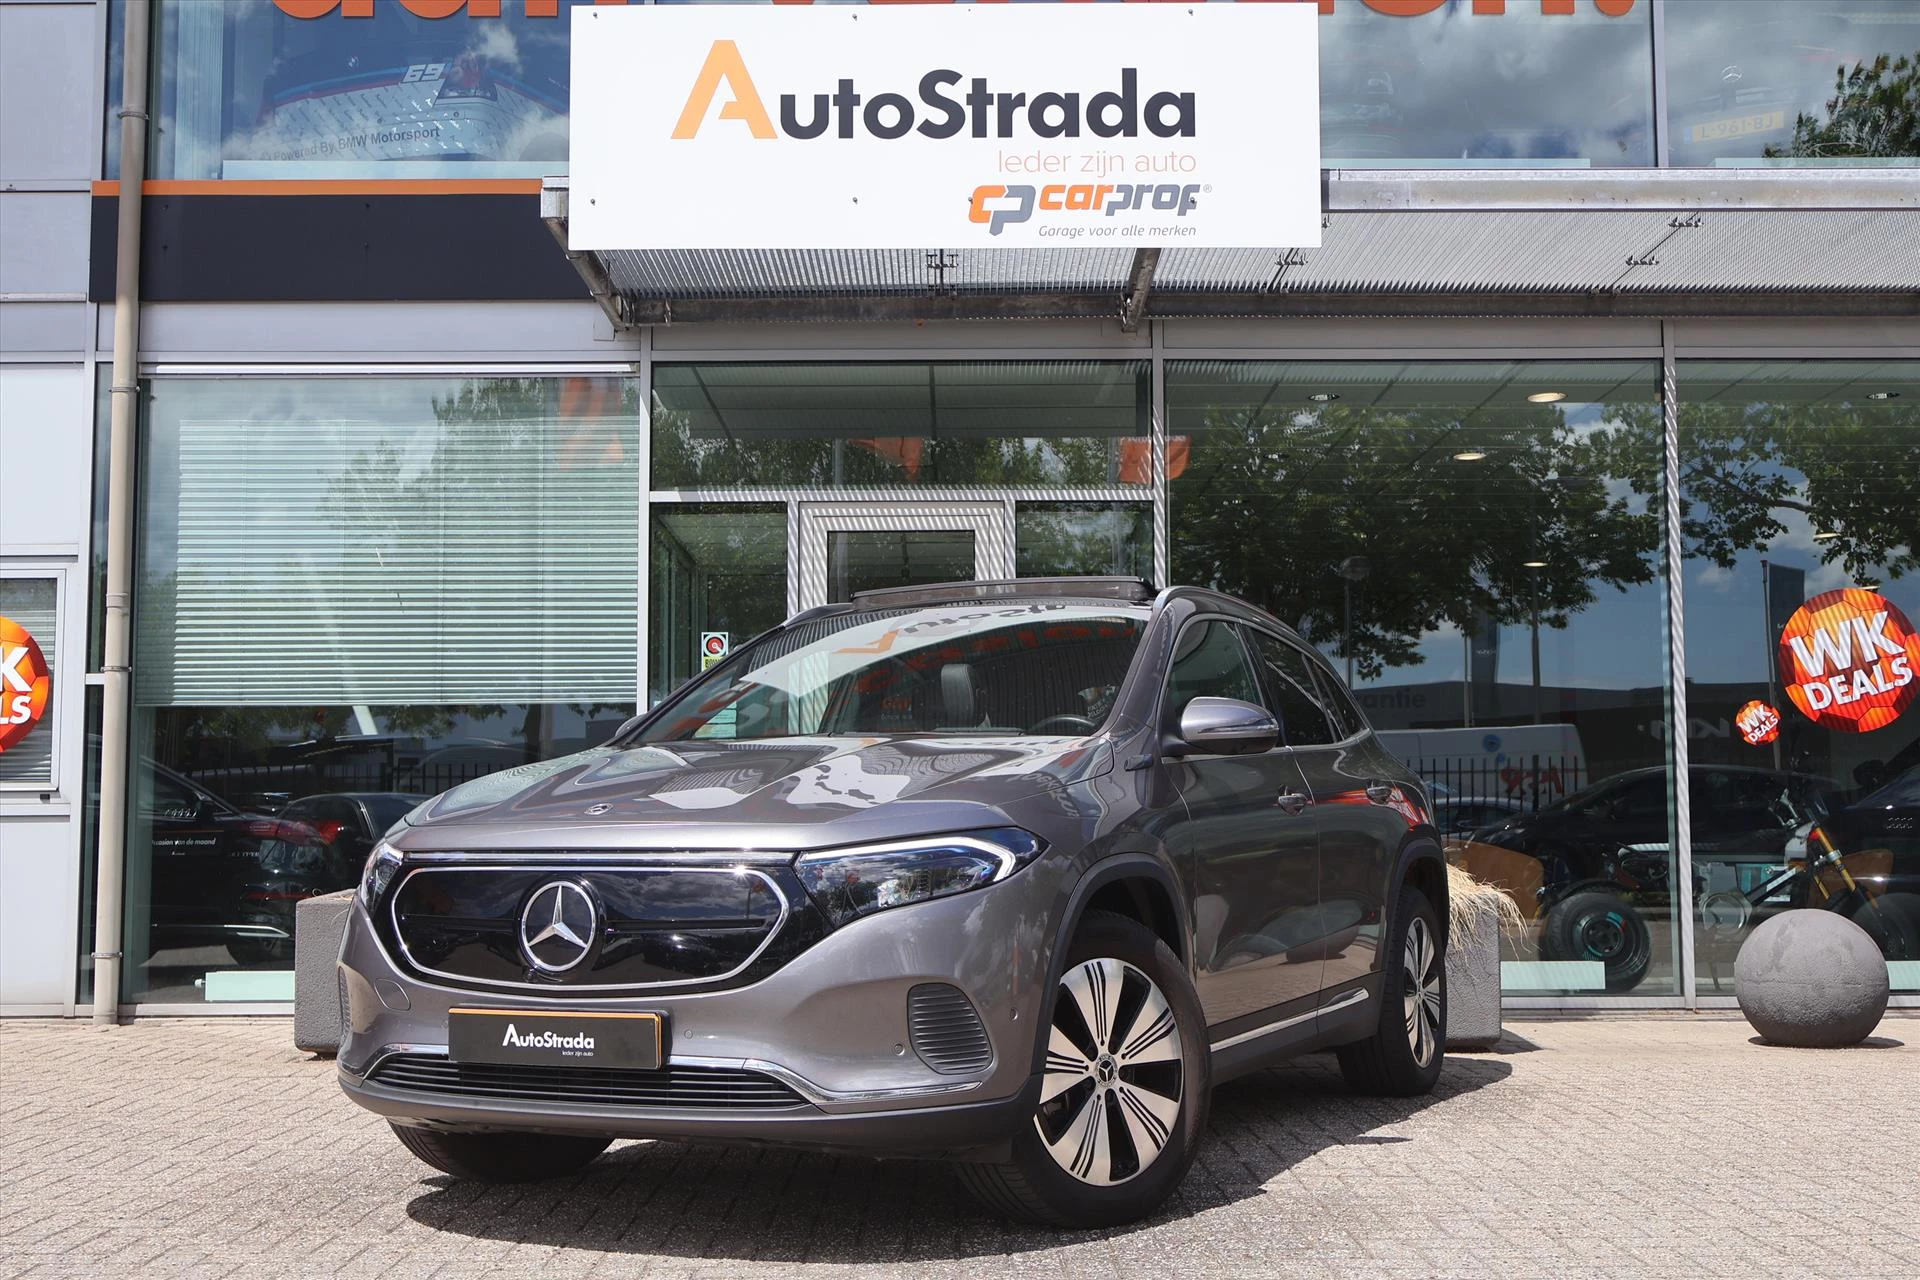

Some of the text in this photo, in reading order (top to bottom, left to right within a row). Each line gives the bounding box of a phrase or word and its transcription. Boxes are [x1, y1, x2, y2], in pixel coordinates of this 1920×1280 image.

[403, 63, 446, 83] 69
[670, 39, 1196, 140] AutoStrada
[273, 126, 441, 161] Powered By BMW Motorsport
[998, 150, 1197, 178] Ieder zijn auto
[1038, 225, 1197, 240] Garage voor alle merken
[1789, 611, 1906, 678] WK
[1802, 656, 1913, 711] DEALS
[1738, 704, 1773, 733] WK
[1748, 715, 1779, 742] DEALS
[502, 1023, 595, 1049] AutoStrada
